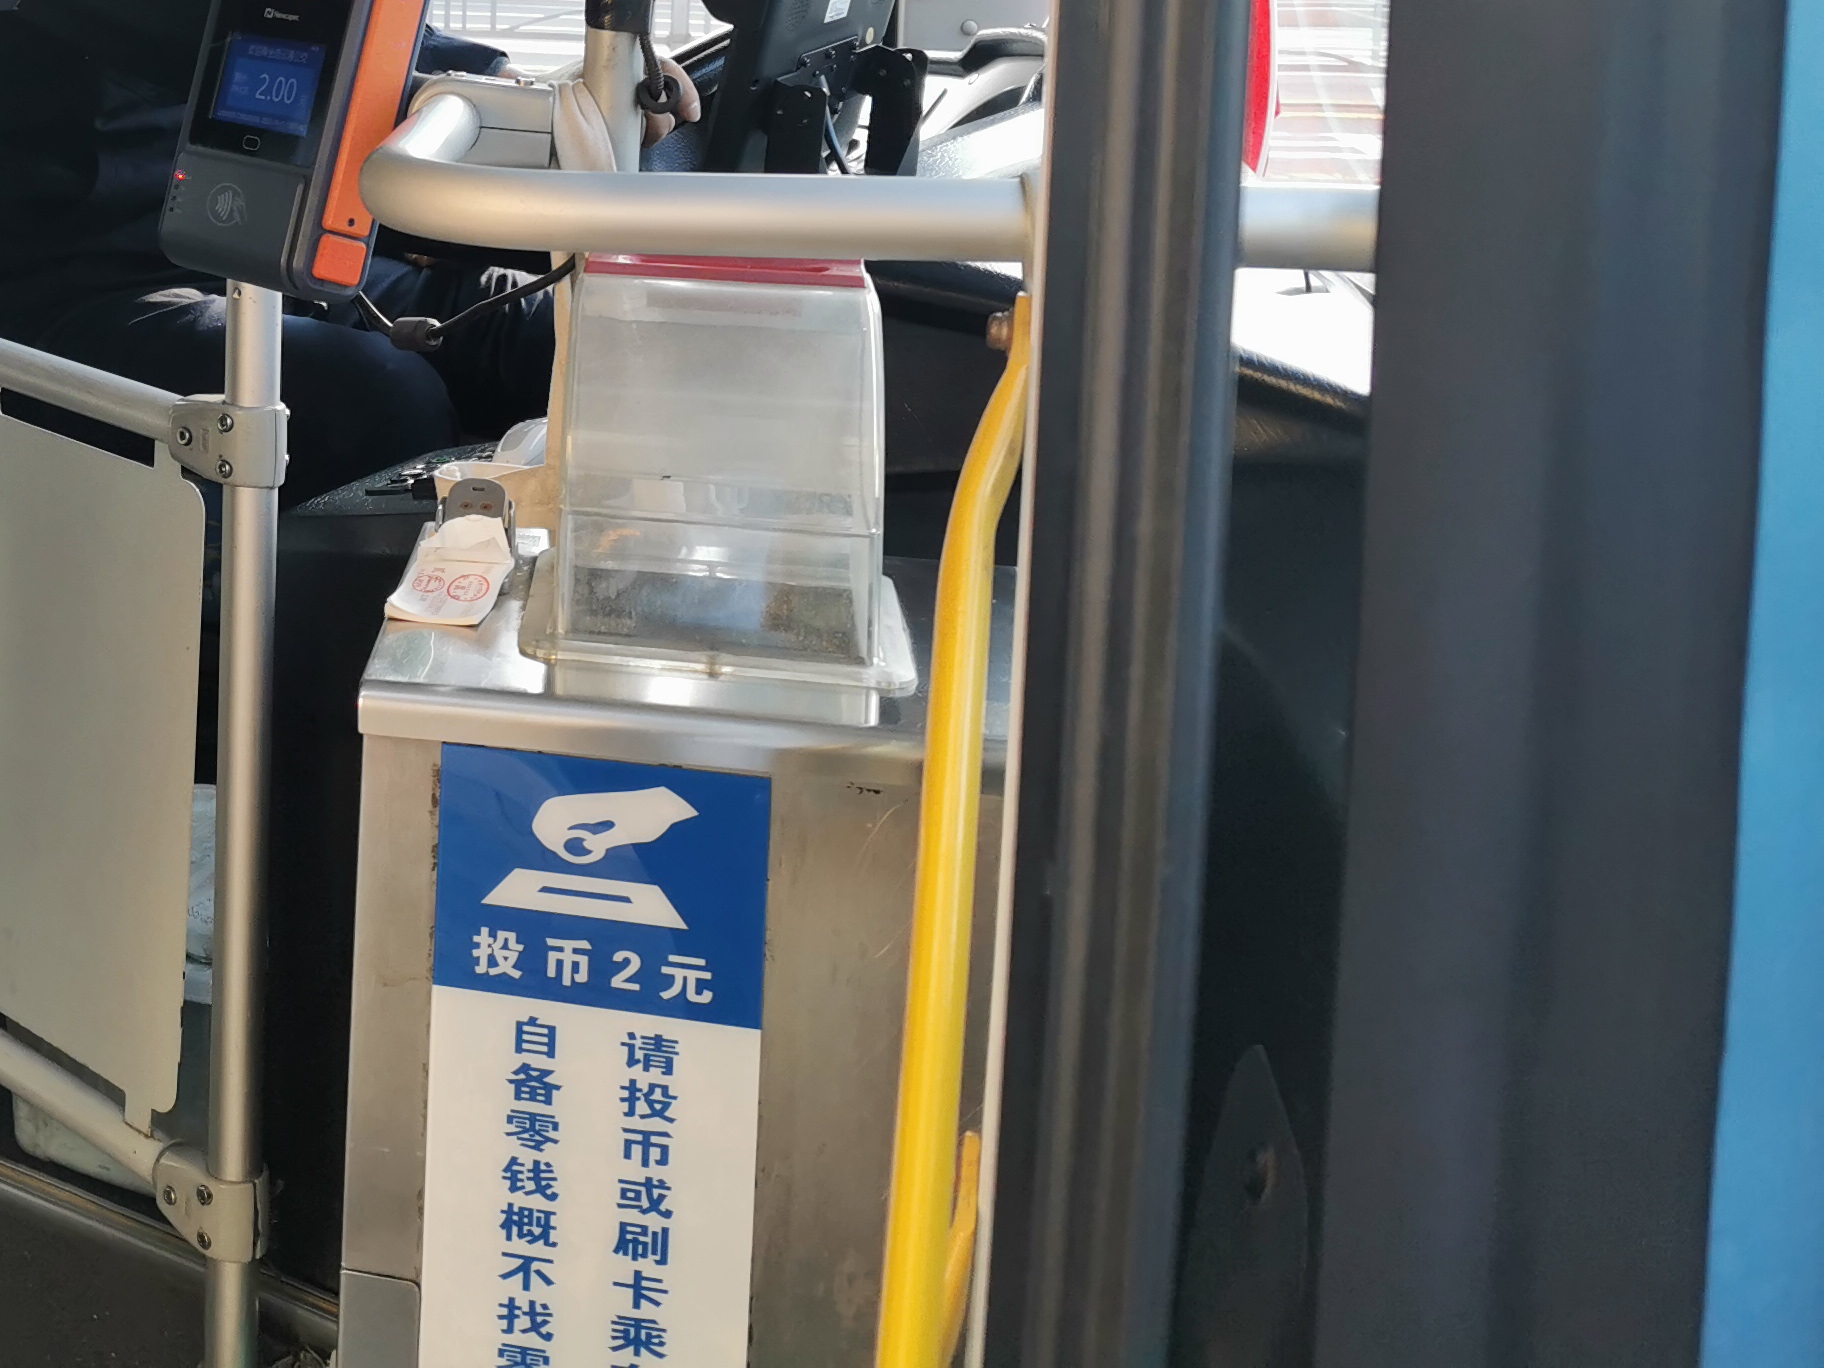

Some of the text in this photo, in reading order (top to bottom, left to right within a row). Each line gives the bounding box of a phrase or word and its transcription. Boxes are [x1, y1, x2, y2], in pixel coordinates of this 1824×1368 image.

[255, 73, 298, 105] 2.00
[472, 927, 715, 1005] 投币2元
[608, 1031, 680, 1368] 请投币或刷卡乘
